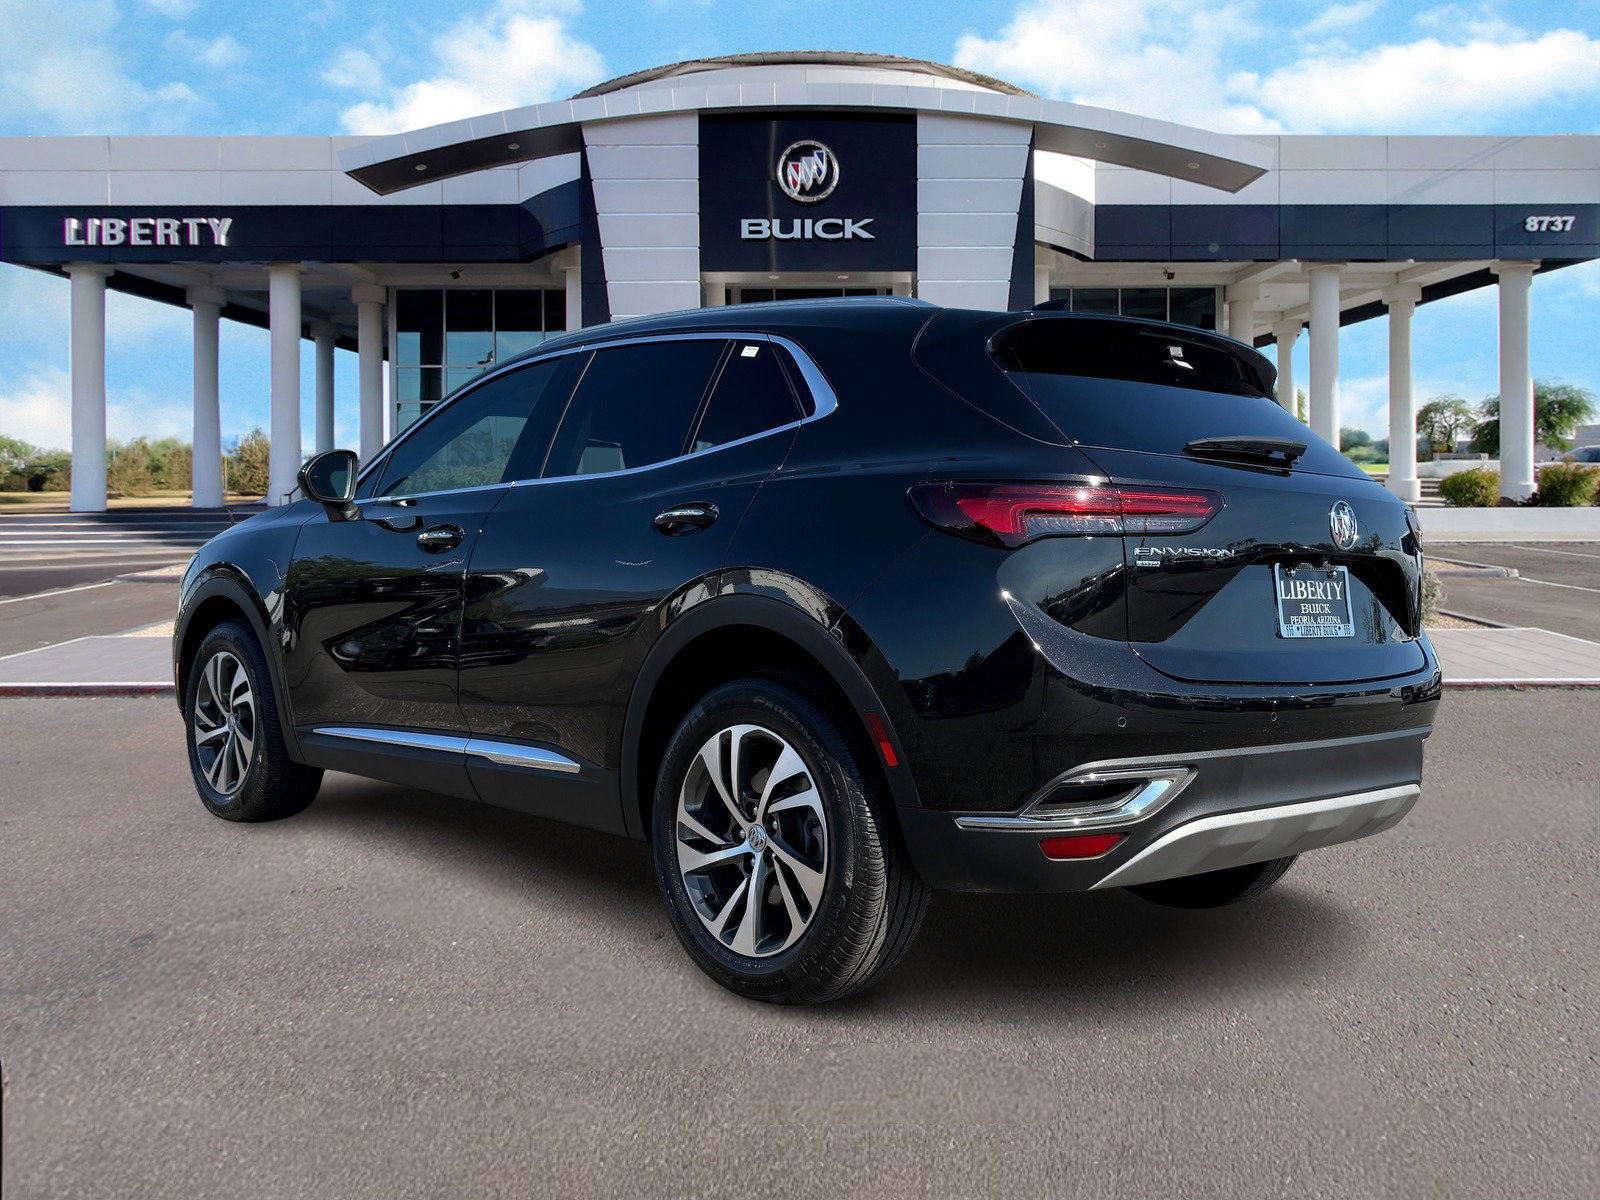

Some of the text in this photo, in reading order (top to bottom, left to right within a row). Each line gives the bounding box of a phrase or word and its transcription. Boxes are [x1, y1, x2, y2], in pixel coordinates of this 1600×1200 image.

[64, 217, 233, 246] LIBERTY
[741, 218, 876, 239] BUICK
[1524, 215, 1576, 232] 8737
[1134, 546, 1235, 557] ENVISION
[1280, 580, 1343, 600] LIBERTY
[1300, 603, 1331, 614] BUICK
[1317, 615, 1342, 625] ARIZONA
